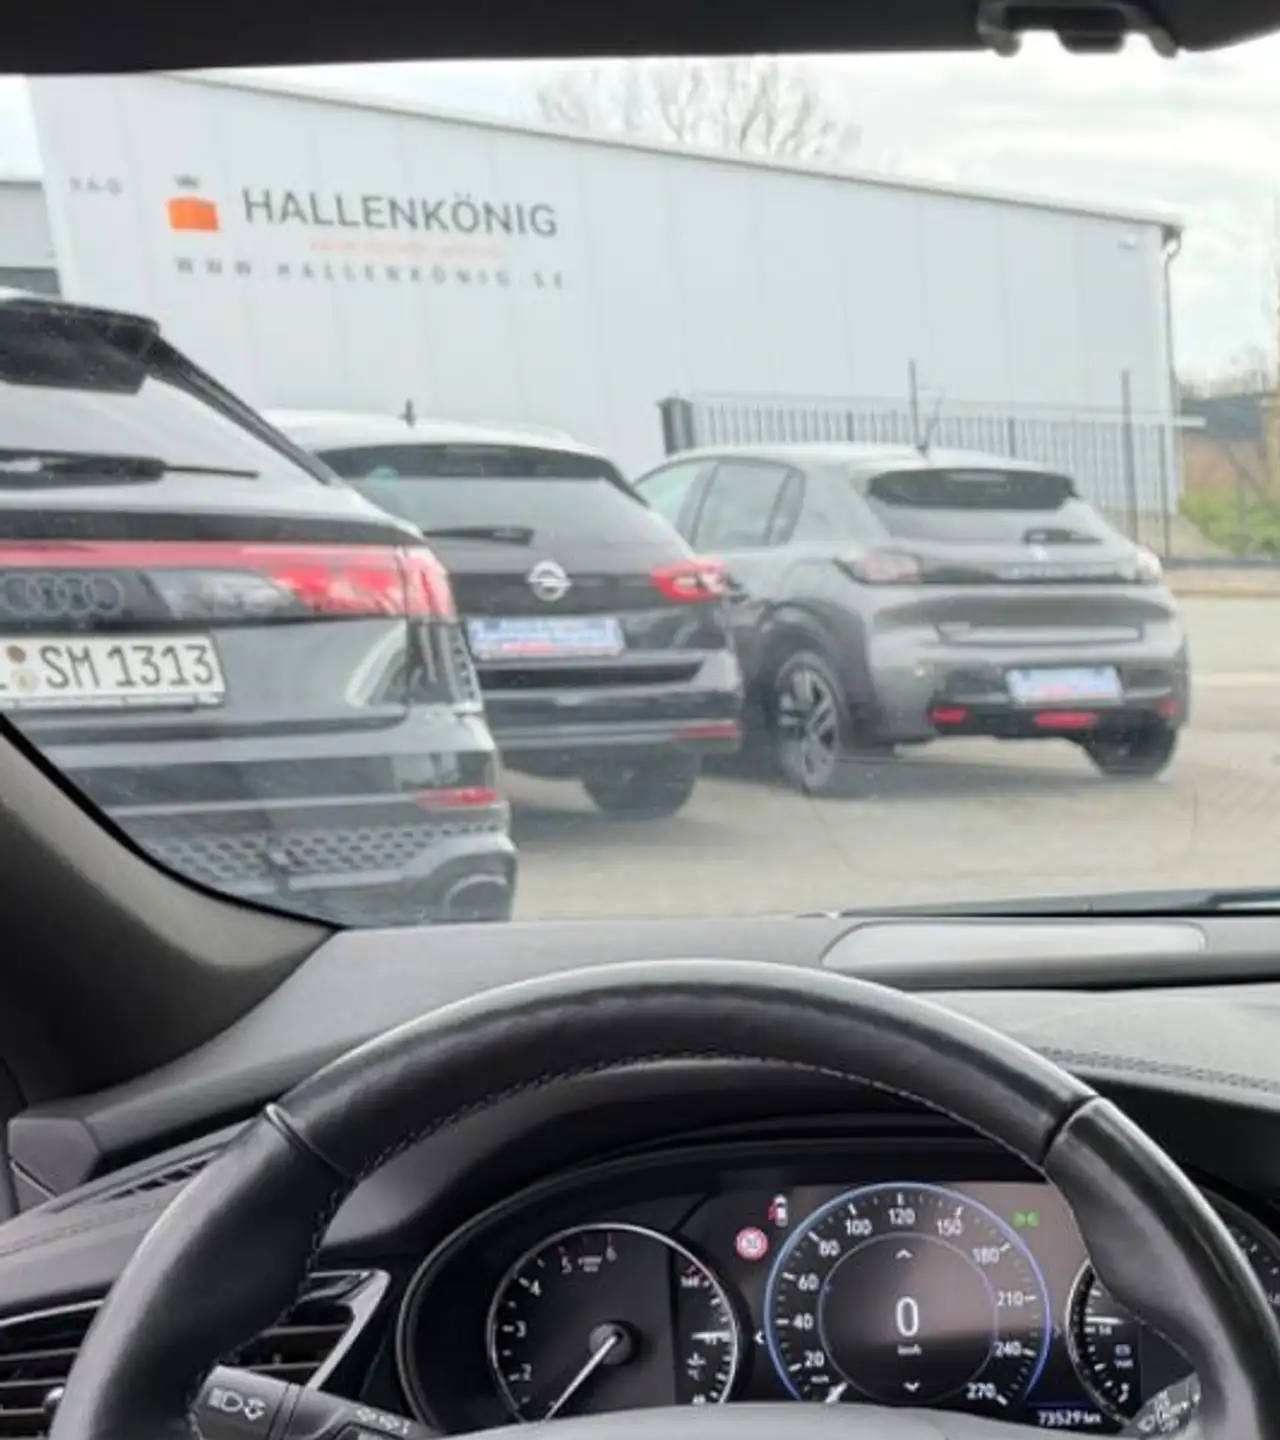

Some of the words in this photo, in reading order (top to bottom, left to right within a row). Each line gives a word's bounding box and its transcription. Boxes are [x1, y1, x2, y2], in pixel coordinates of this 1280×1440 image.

[243, 187, 558, 238] HALLENKÖNIG
[39, 645, 100, 688] SM
[107, 644, 214, 687] 1313
[888, 1209, 915, 1224] 120
[844, 1219, 872, 1235] 100
[937, 1220, 963, 1236] 150
[819, 1241, 840, 1256] 80
[562, 1256, 572, 1274] 5
[972, 1249, 999, 1265] 180
[530, 1280, 541, 1296] 4
[798, 1274, 819, 1290] 60
[996, 1291, 1023, 1306] 210
[793, 1314, 813, 1329] 40
[896, 1296, 919, 1337] 0
[516, 1320, 526, 1337] 3
[995, 1342, 1021, 1357] 240
[804, 1353, 824, 1367] 20
[522, 1364, 532, 1381] 2
[967, 1384, 997, 1399] 270
[1038, 1412, 1081, 1424] 73529
